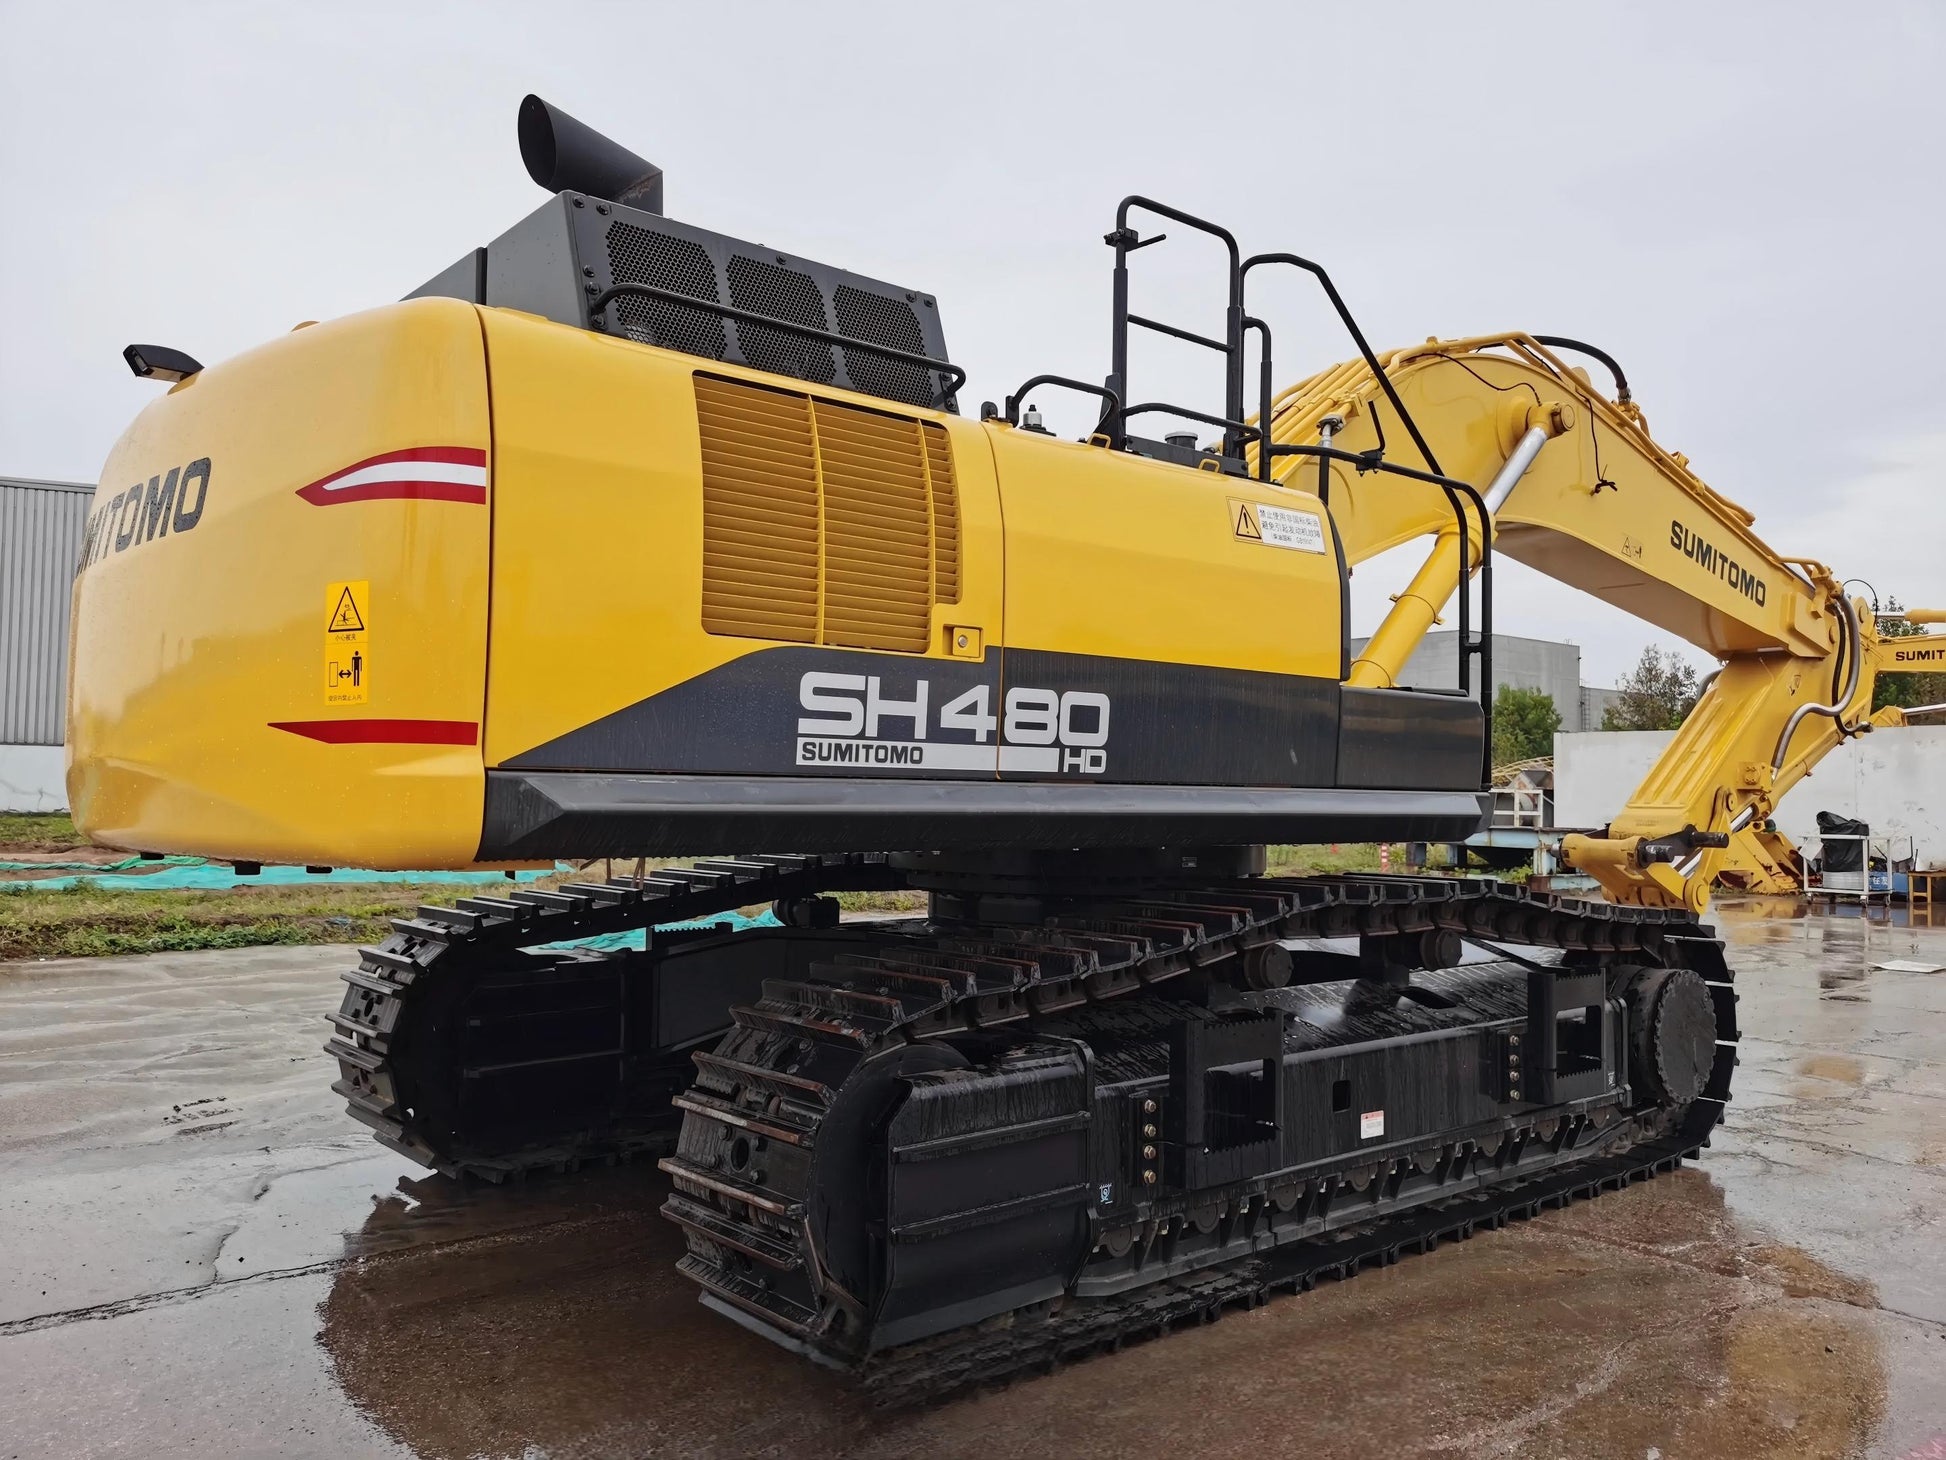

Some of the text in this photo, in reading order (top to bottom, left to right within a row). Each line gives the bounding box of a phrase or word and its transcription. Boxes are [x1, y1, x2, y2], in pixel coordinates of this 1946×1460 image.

[1670, 520, 1766, 608] SUMITOMO
[1895, 649, 1945, 661] SUMIT
[801, 741, 924, 765] SUMITOMO
[1063, 748, 1107, 774] HD
